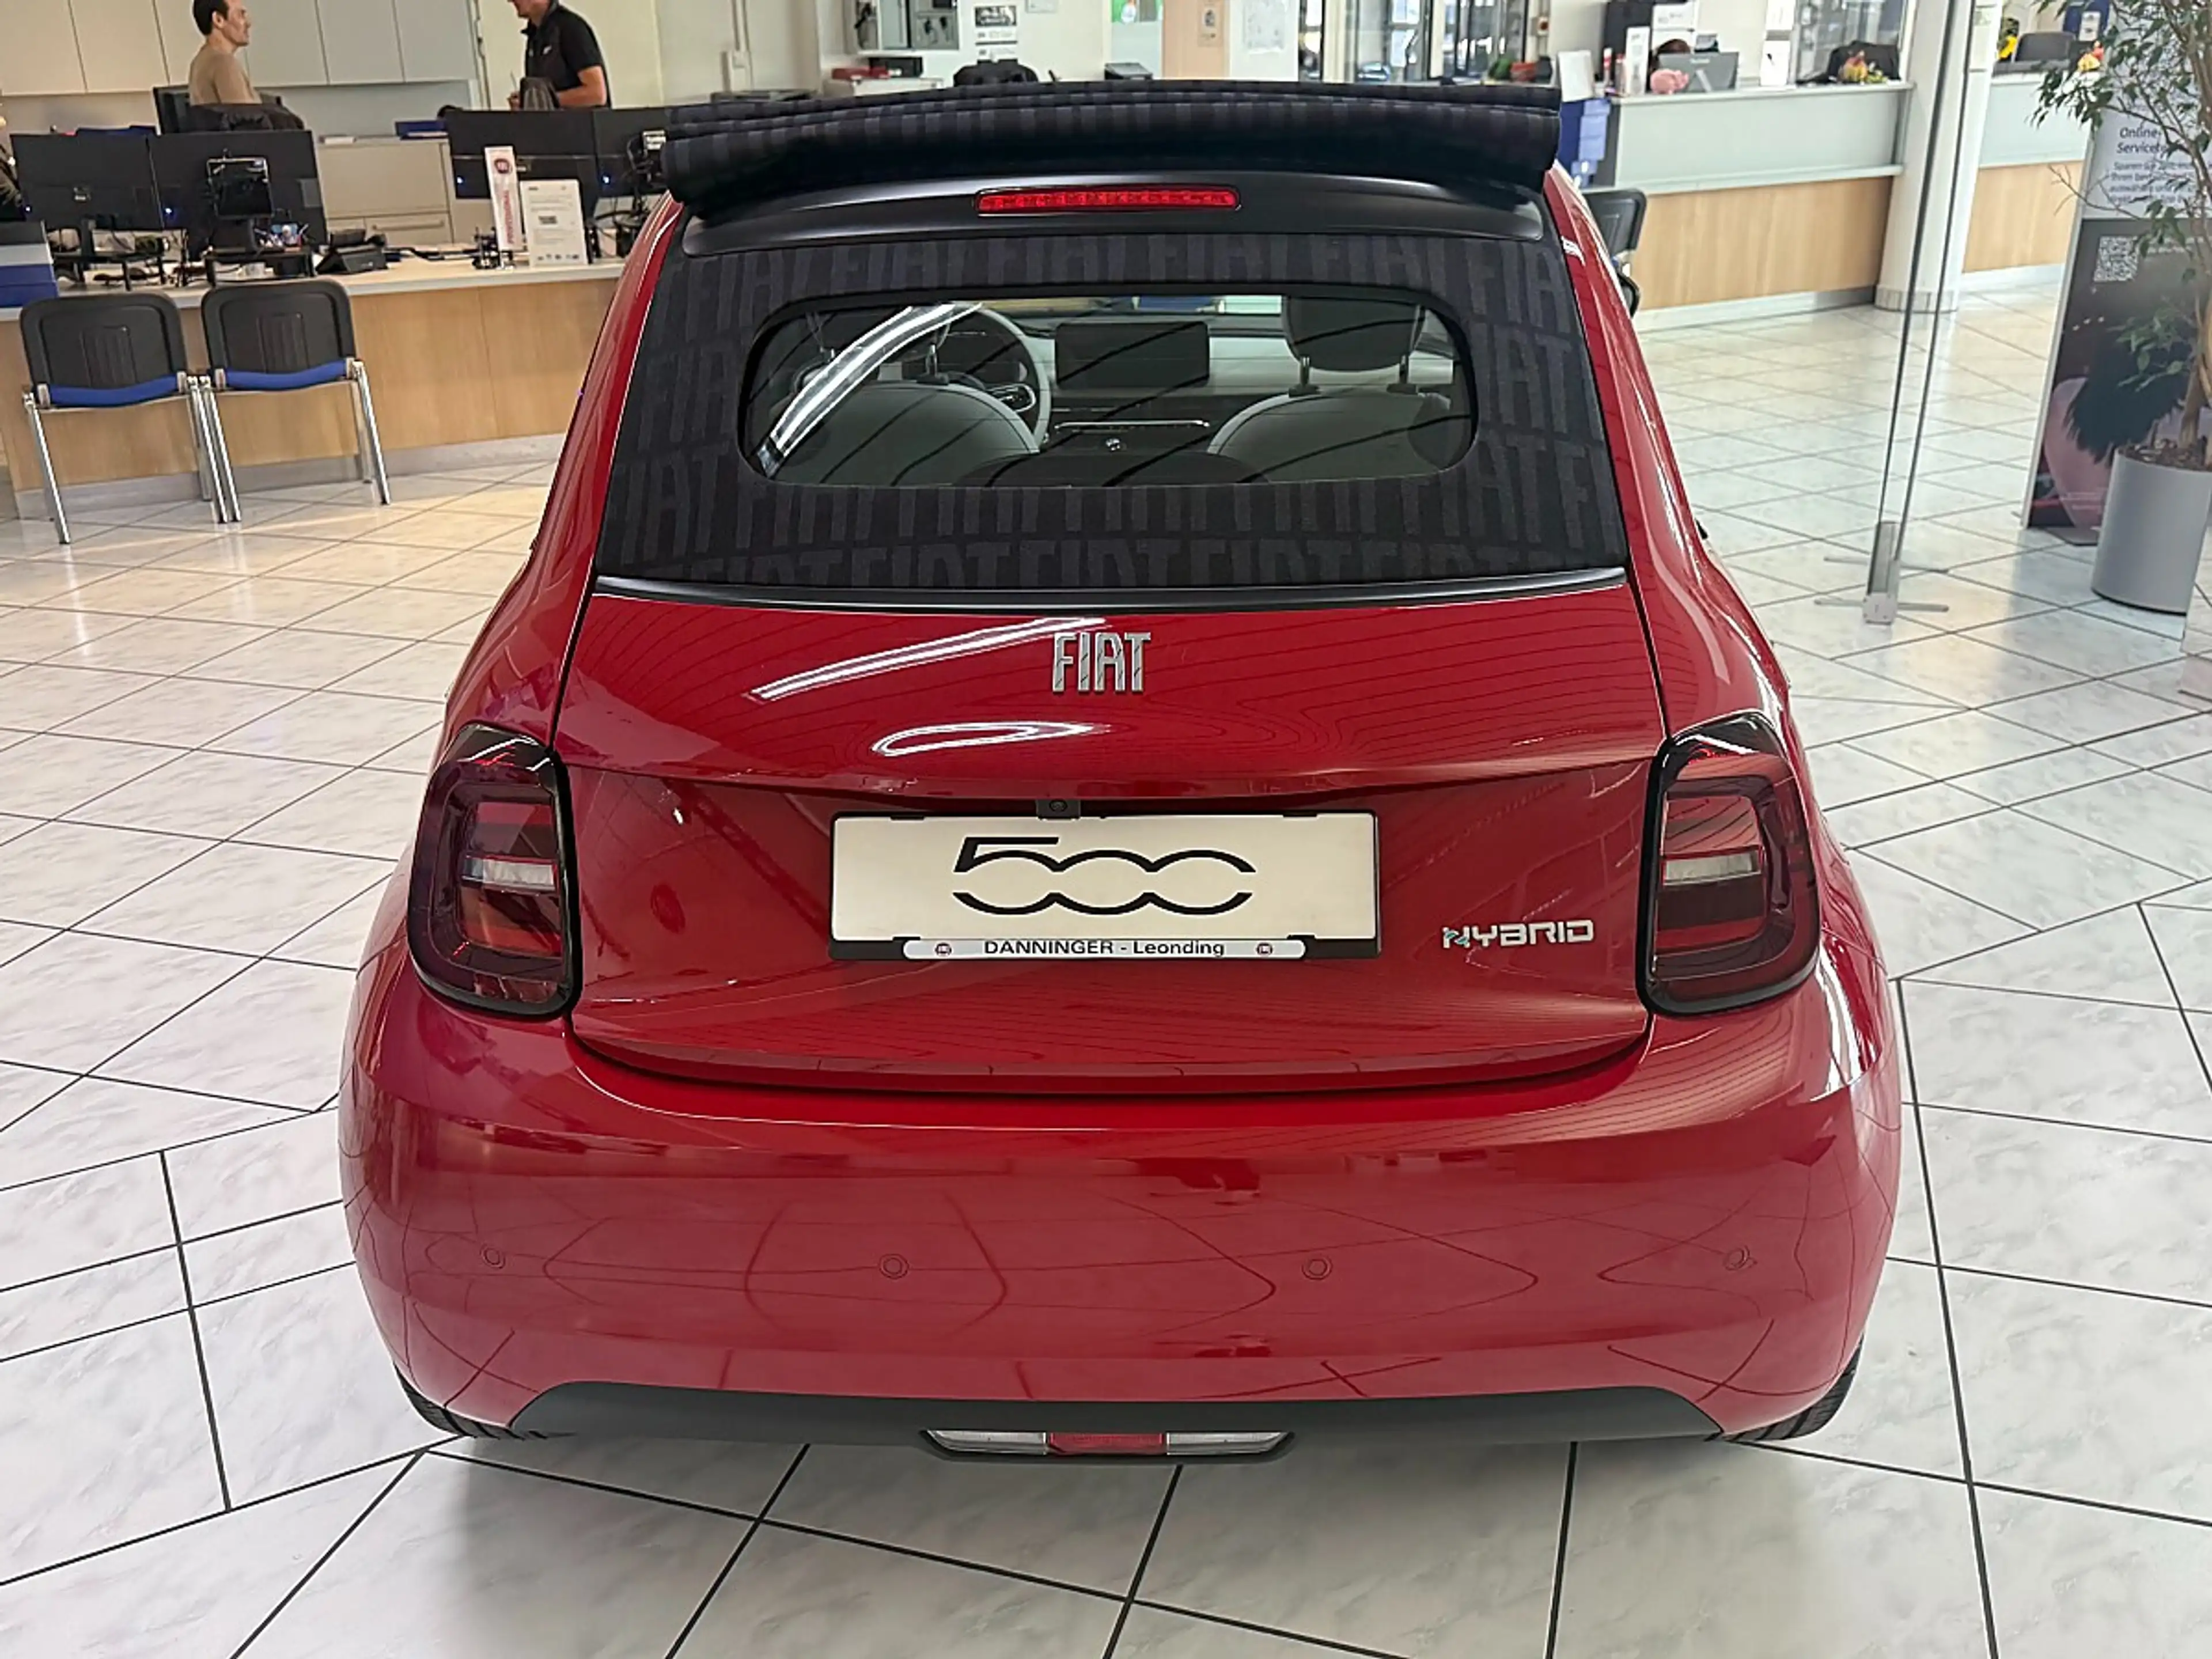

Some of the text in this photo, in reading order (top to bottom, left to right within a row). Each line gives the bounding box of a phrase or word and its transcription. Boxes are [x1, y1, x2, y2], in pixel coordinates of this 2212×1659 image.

[2119, 127, 2162, 139] Online-
[1052, 632, 1151, 693] FIAT
[952, 836, 1256, 915] 500
[1442, 919, 1594, 948] HYBRID
[984, 941, 1113, 955] DANNINGER
[1133, 941, 1225, 959] Leonding
